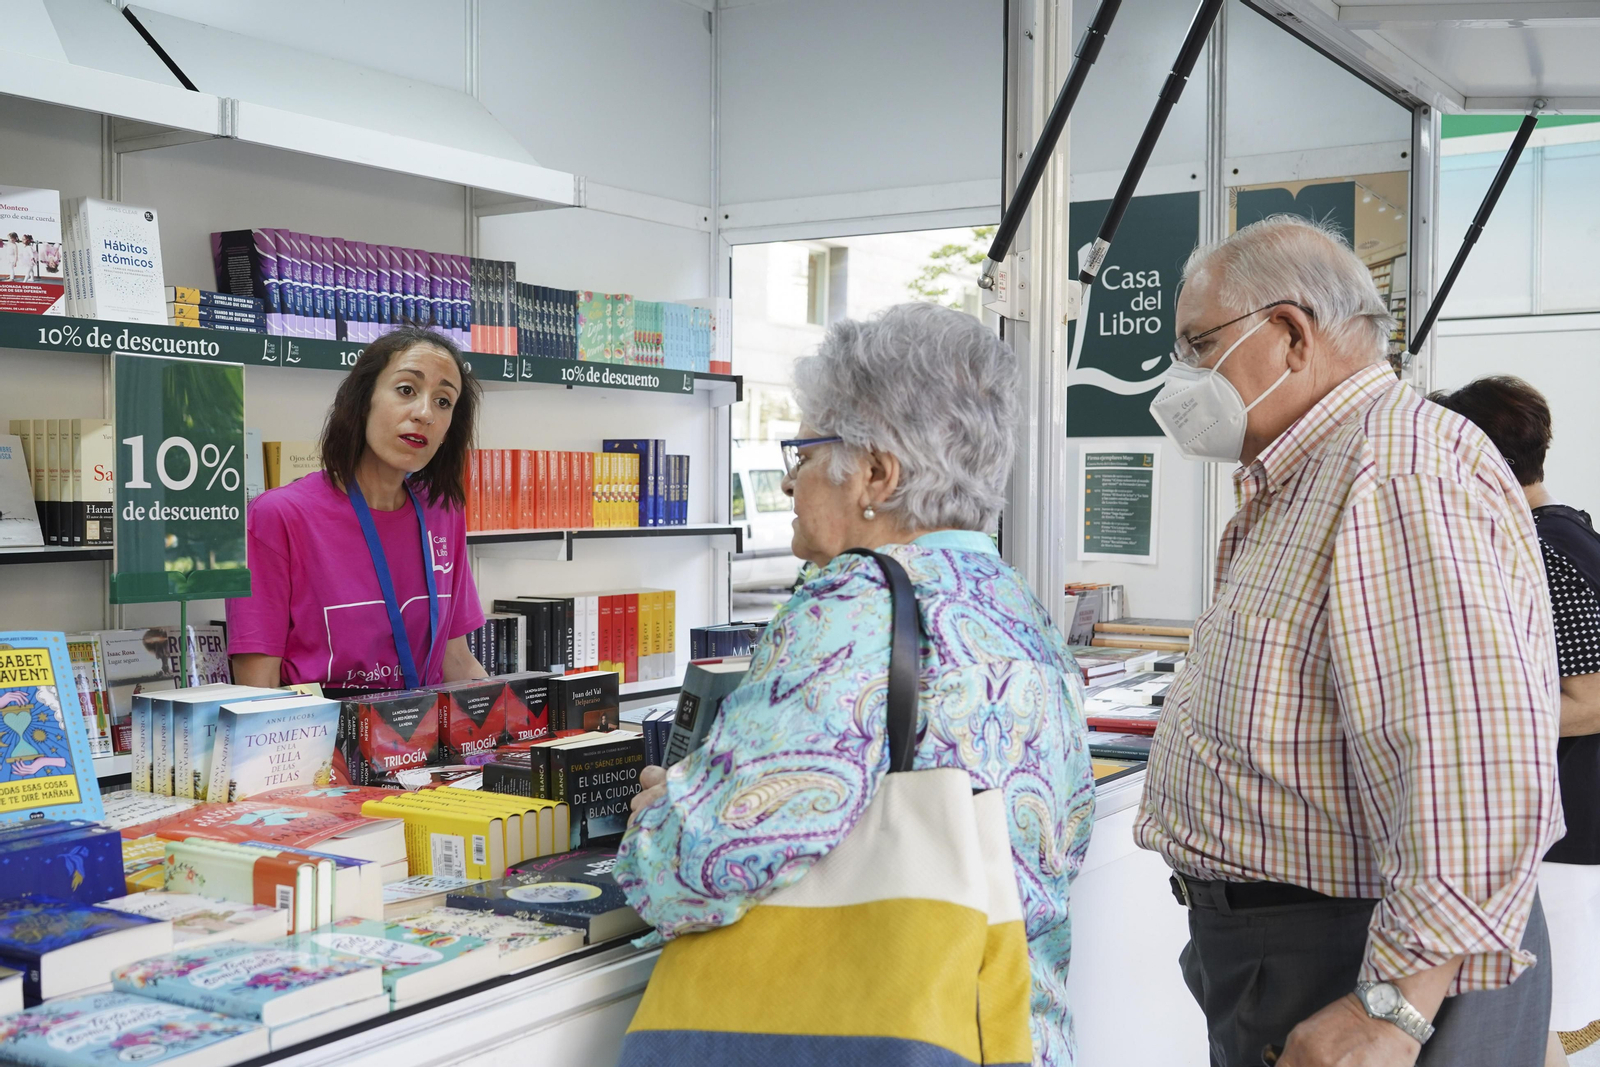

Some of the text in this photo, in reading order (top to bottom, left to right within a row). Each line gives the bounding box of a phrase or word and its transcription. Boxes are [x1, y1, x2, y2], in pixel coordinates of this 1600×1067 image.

[0, 204, 29, 212] Montero
[36, 214, 55, 223] cuerda
[103, 238, 148, 255] Hábitos
[101, 253, 154, 269] atómicos
[1102, 265, 1161, 290] Casa
[1131, 290, 1162, 311] del
[1100, 311, 1162, 336] Libro
[38, 325, 220, 357] 10% de descuento
[561, 365, 660, 388] 10% de descuento
[122, 434, 240, 492] 10%
[289, 455, 305, 463] Ojos
[122, 501, 240, 521] de descuento
[572, 691, 585, 700] Juan
[575, 697, 601, 707] Delparaíso
[265, 712, 316, 725] ANNE JACOBS
[244, 724, 328, 749] TORMENTA
[461, 734, 496, 753] TRILOGÍA
[220, 724, 231, 773] TORMENTA
[276, 744, 286, 753] EN
[269, 750, 301, 766] VILLA
[384, 748, 428, 768] TRILOGÍA
[571, 764, 583, 773] EVA
[595, 757, 614, 769] SÁENZ
[624, 754, 642, 764] URTURI
[271, 762, 296, 773] DE LAS
[22, 783, 42, 793] ESAS
[43, 780, 69, 790] COSAS
[264, 770, 300, 787] TELAS
[578, 768, 637, 788] EL SILENCIO
[8, 796, 20, 804] TE
[21, 793, 40, 802] DIRÉ
[42, 789, 75, 799] MAÑANA
[574, 783, 642, 805] DE LA CIUDAD
[589, 802, 629, 819] BLANCA
